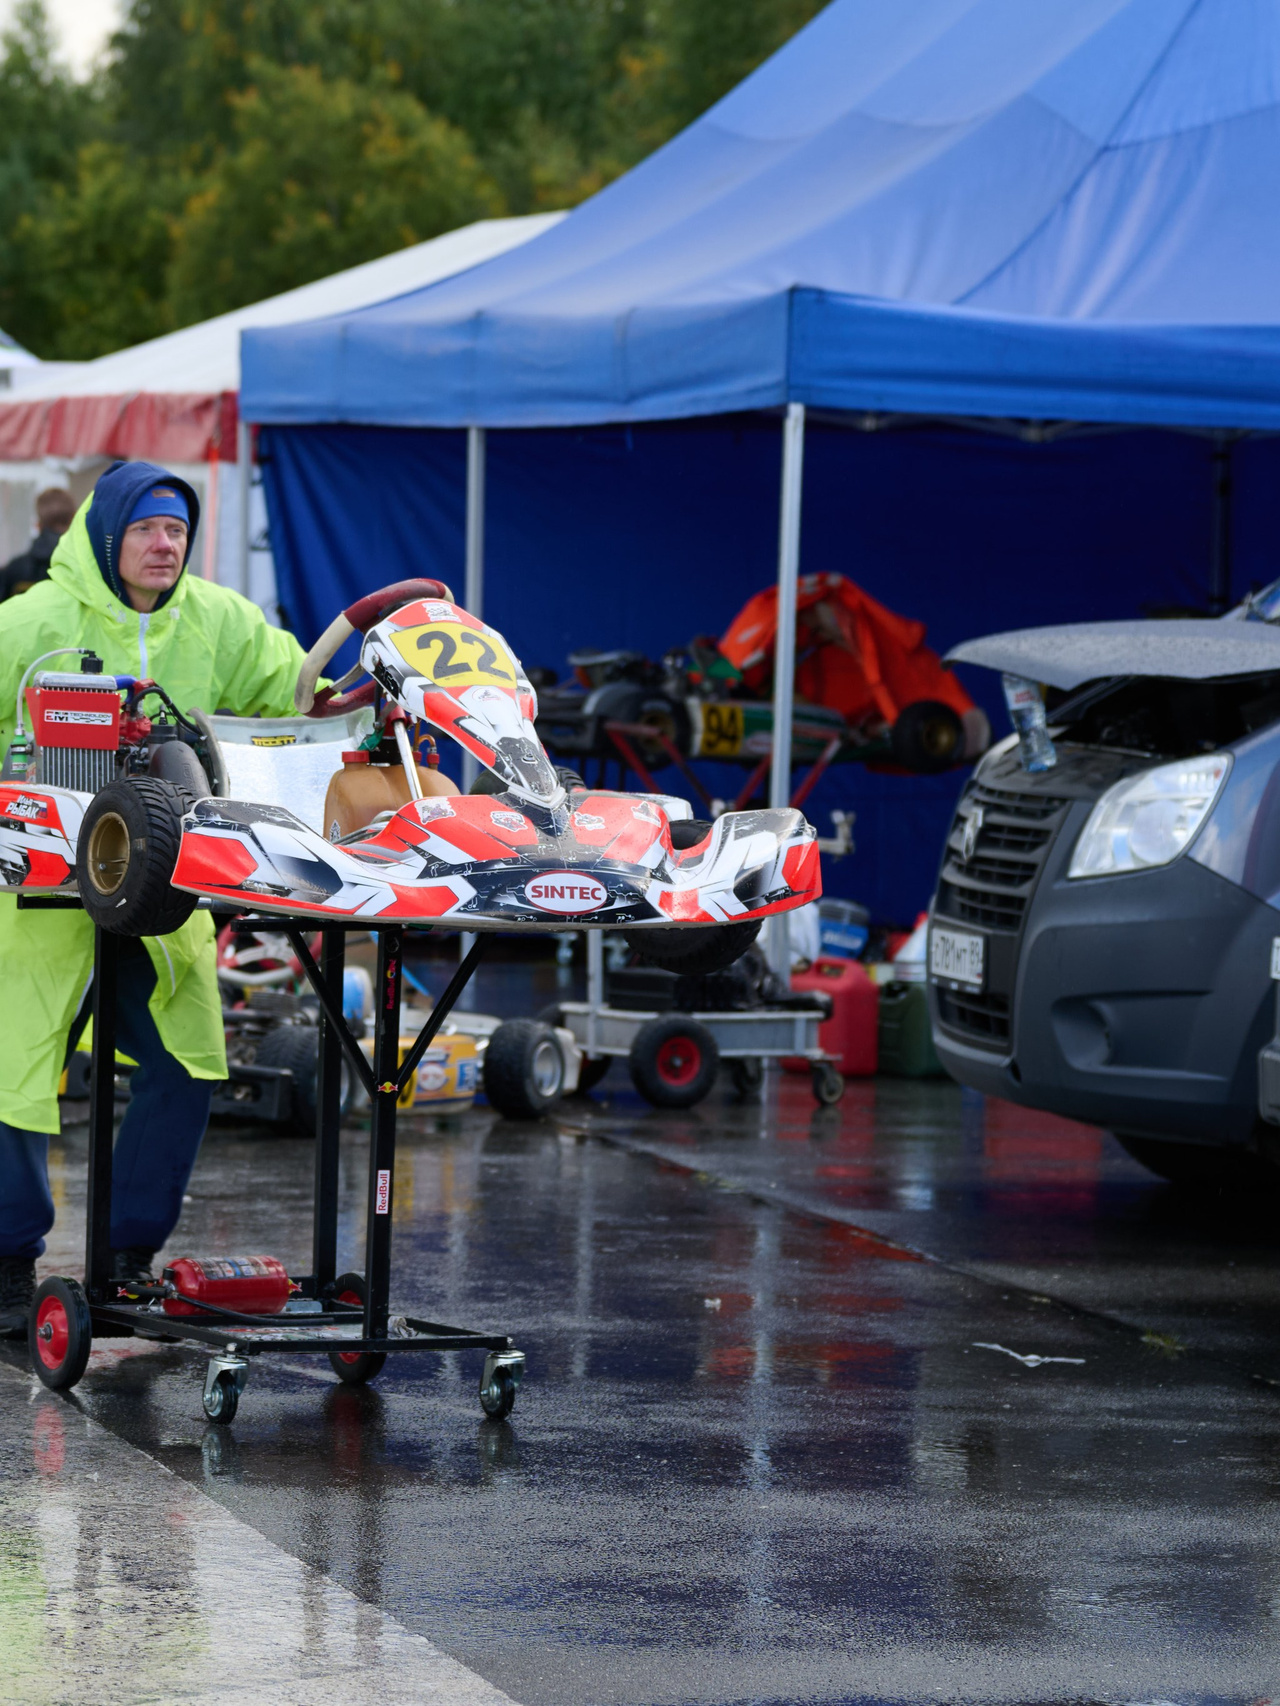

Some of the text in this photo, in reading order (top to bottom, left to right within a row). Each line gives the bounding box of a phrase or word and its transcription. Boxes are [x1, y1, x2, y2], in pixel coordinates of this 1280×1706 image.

[416, 631, 513, 681] 22
[706, 706, 738, 750] 94
[5, 801, 40, 820] РЫБАК
[531, 885, 602, 900] SINTEC
